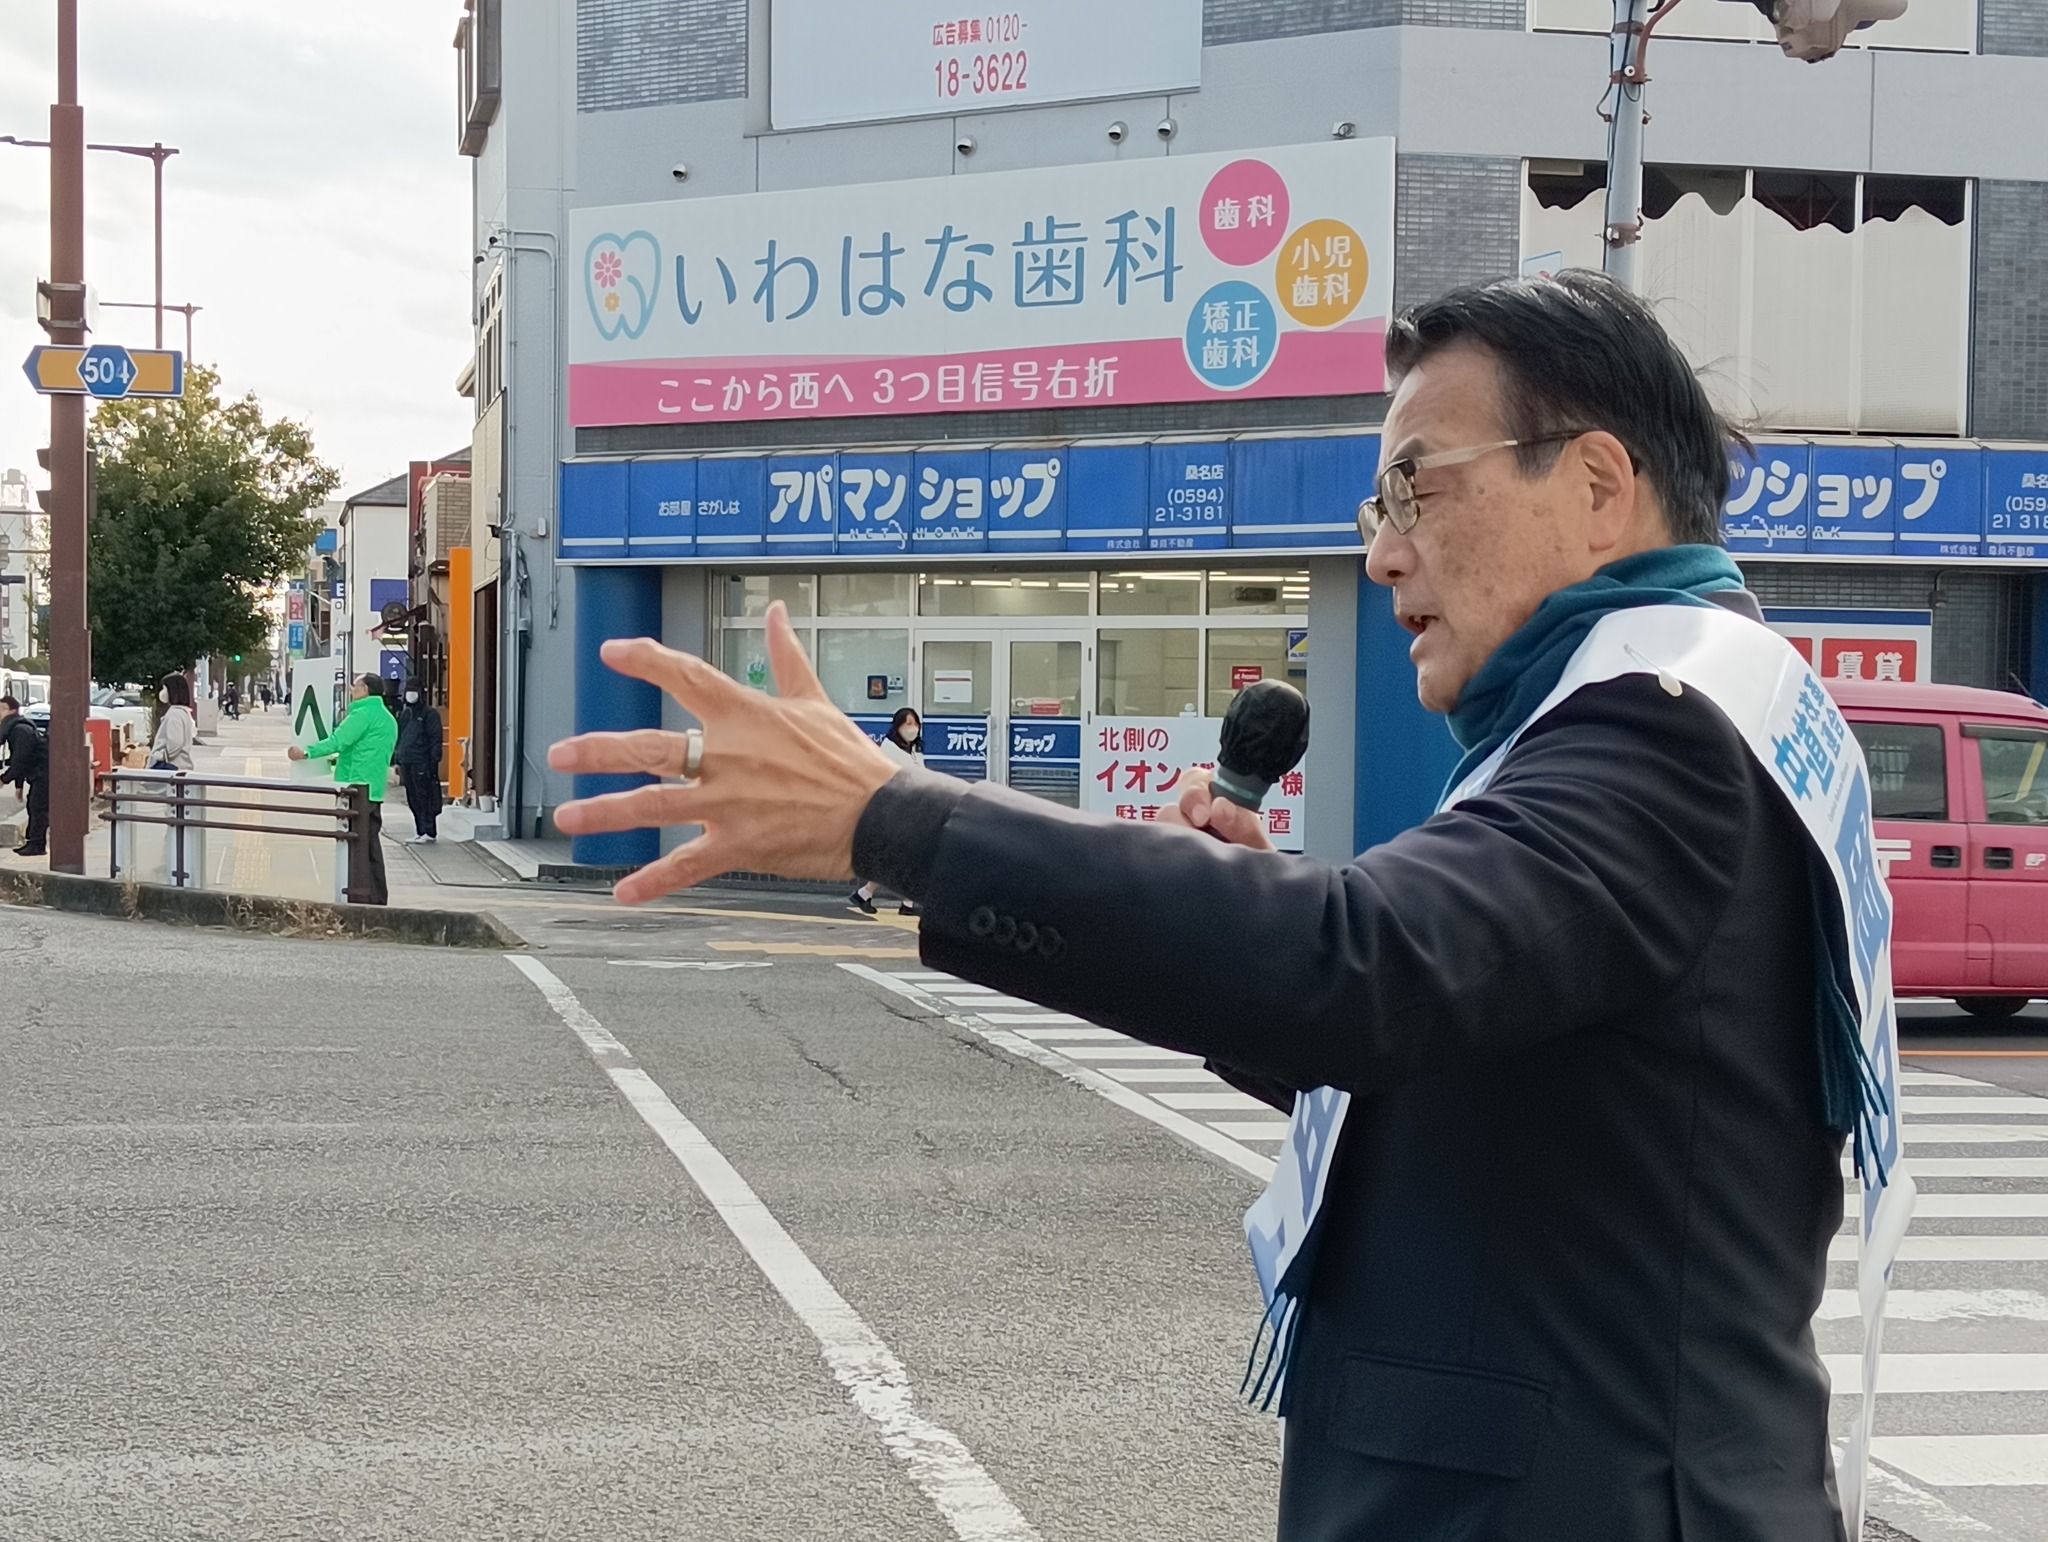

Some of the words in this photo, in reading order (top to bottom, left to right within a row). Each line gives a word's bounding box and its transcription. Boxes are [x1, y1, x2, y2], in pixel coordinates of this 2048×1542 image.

[933, 19, 981, 46] 広告募集
[935, 50, 1027, 98] 18-3622
[1213, 194, 1275, 230] 歯科
[675, 206, 1184, 325] いわはな歯科
[1291, 235, 1352, 271] 小児
[1291, 272, 1352, 307] 歯科
[1201, 300, 1261, 335] 矯正
[1201, 336, 1260, 369] 歯科
[84, 357, 130, 384] 504
[657, 372, 854, 413] ここから西へ
[873, 356, 1119, 404] 3つ目信号右折
[770, 458, 1061, 523] アパマンショップ
[1167, 487, 1225, 506] (0594)
[2005, 495, 2048, 512] (059
[1155, 506, 1223, 522] 21-3181
[1098, 727, 1169, 752] 北側の
